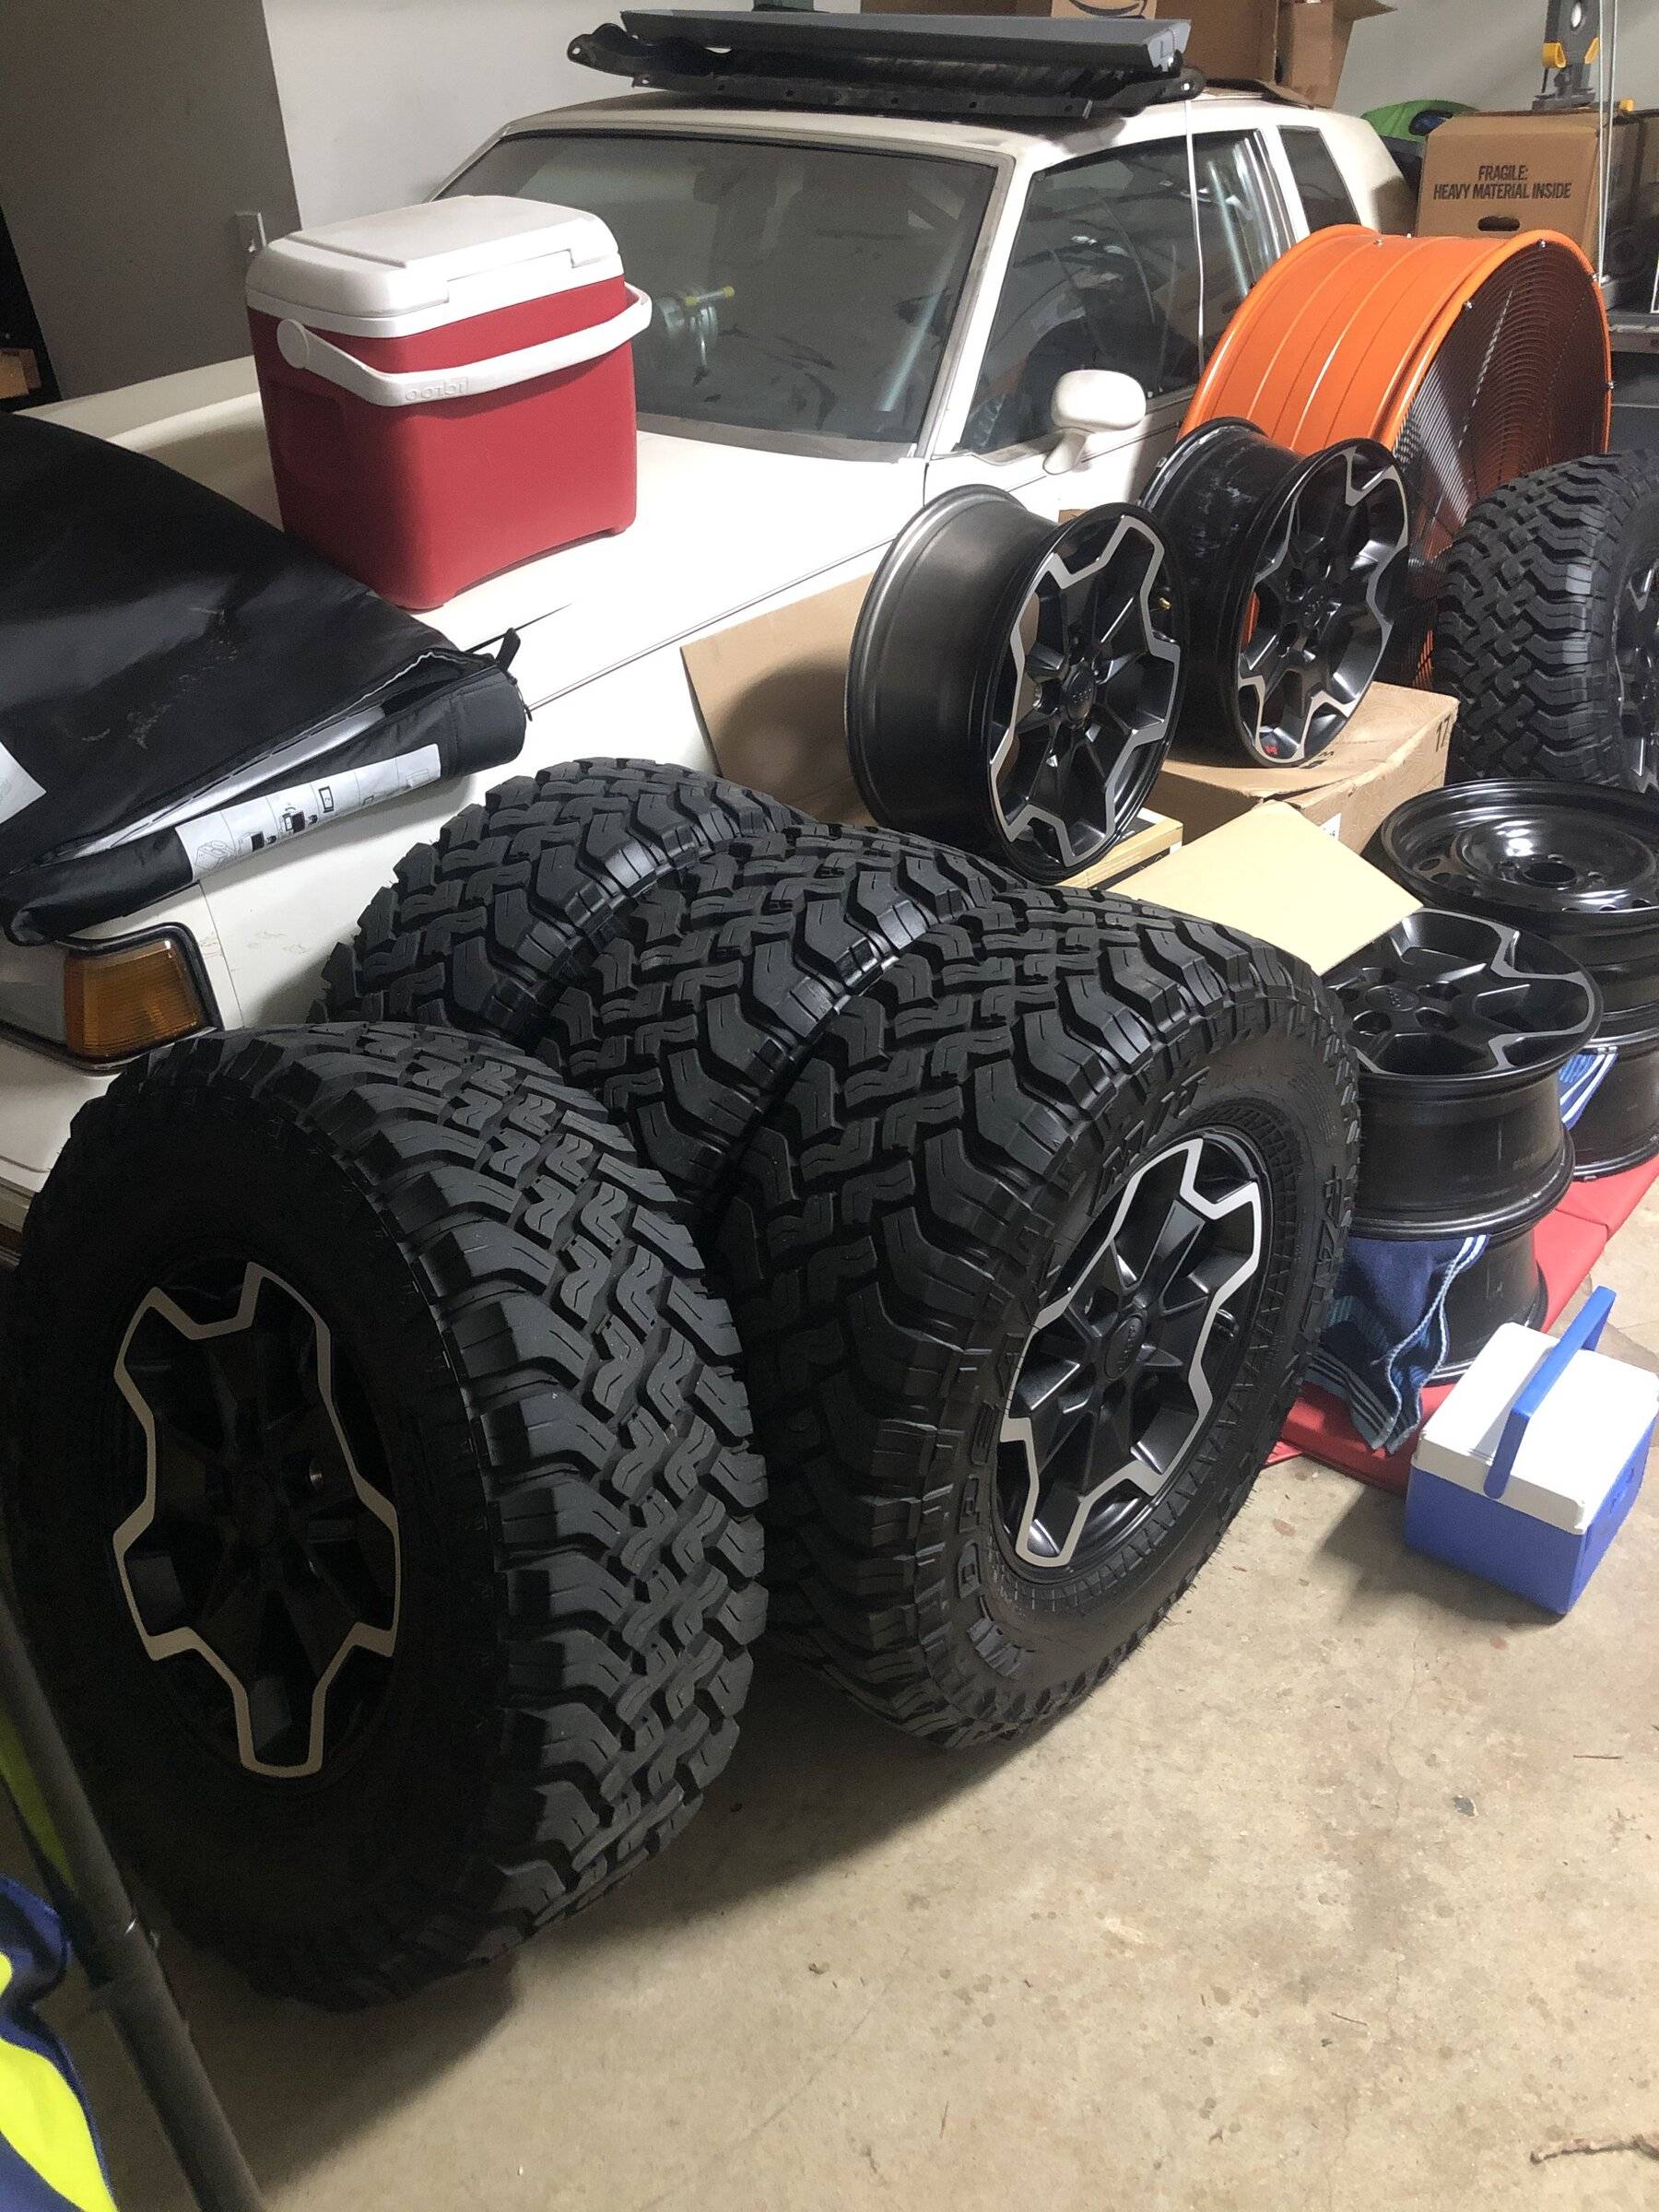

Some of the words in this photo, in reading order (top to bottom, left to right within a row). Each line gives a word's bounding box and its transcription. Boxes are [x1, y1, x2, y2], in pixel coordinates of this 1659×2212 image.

[1477, 164, 1528, 181] FRAGILE:
[1433, 184, 1470, 199] HEAVY
[1473, 184, 1529, 199] MATERIAL
[1532, 182, 1572, 199] INSIDE
